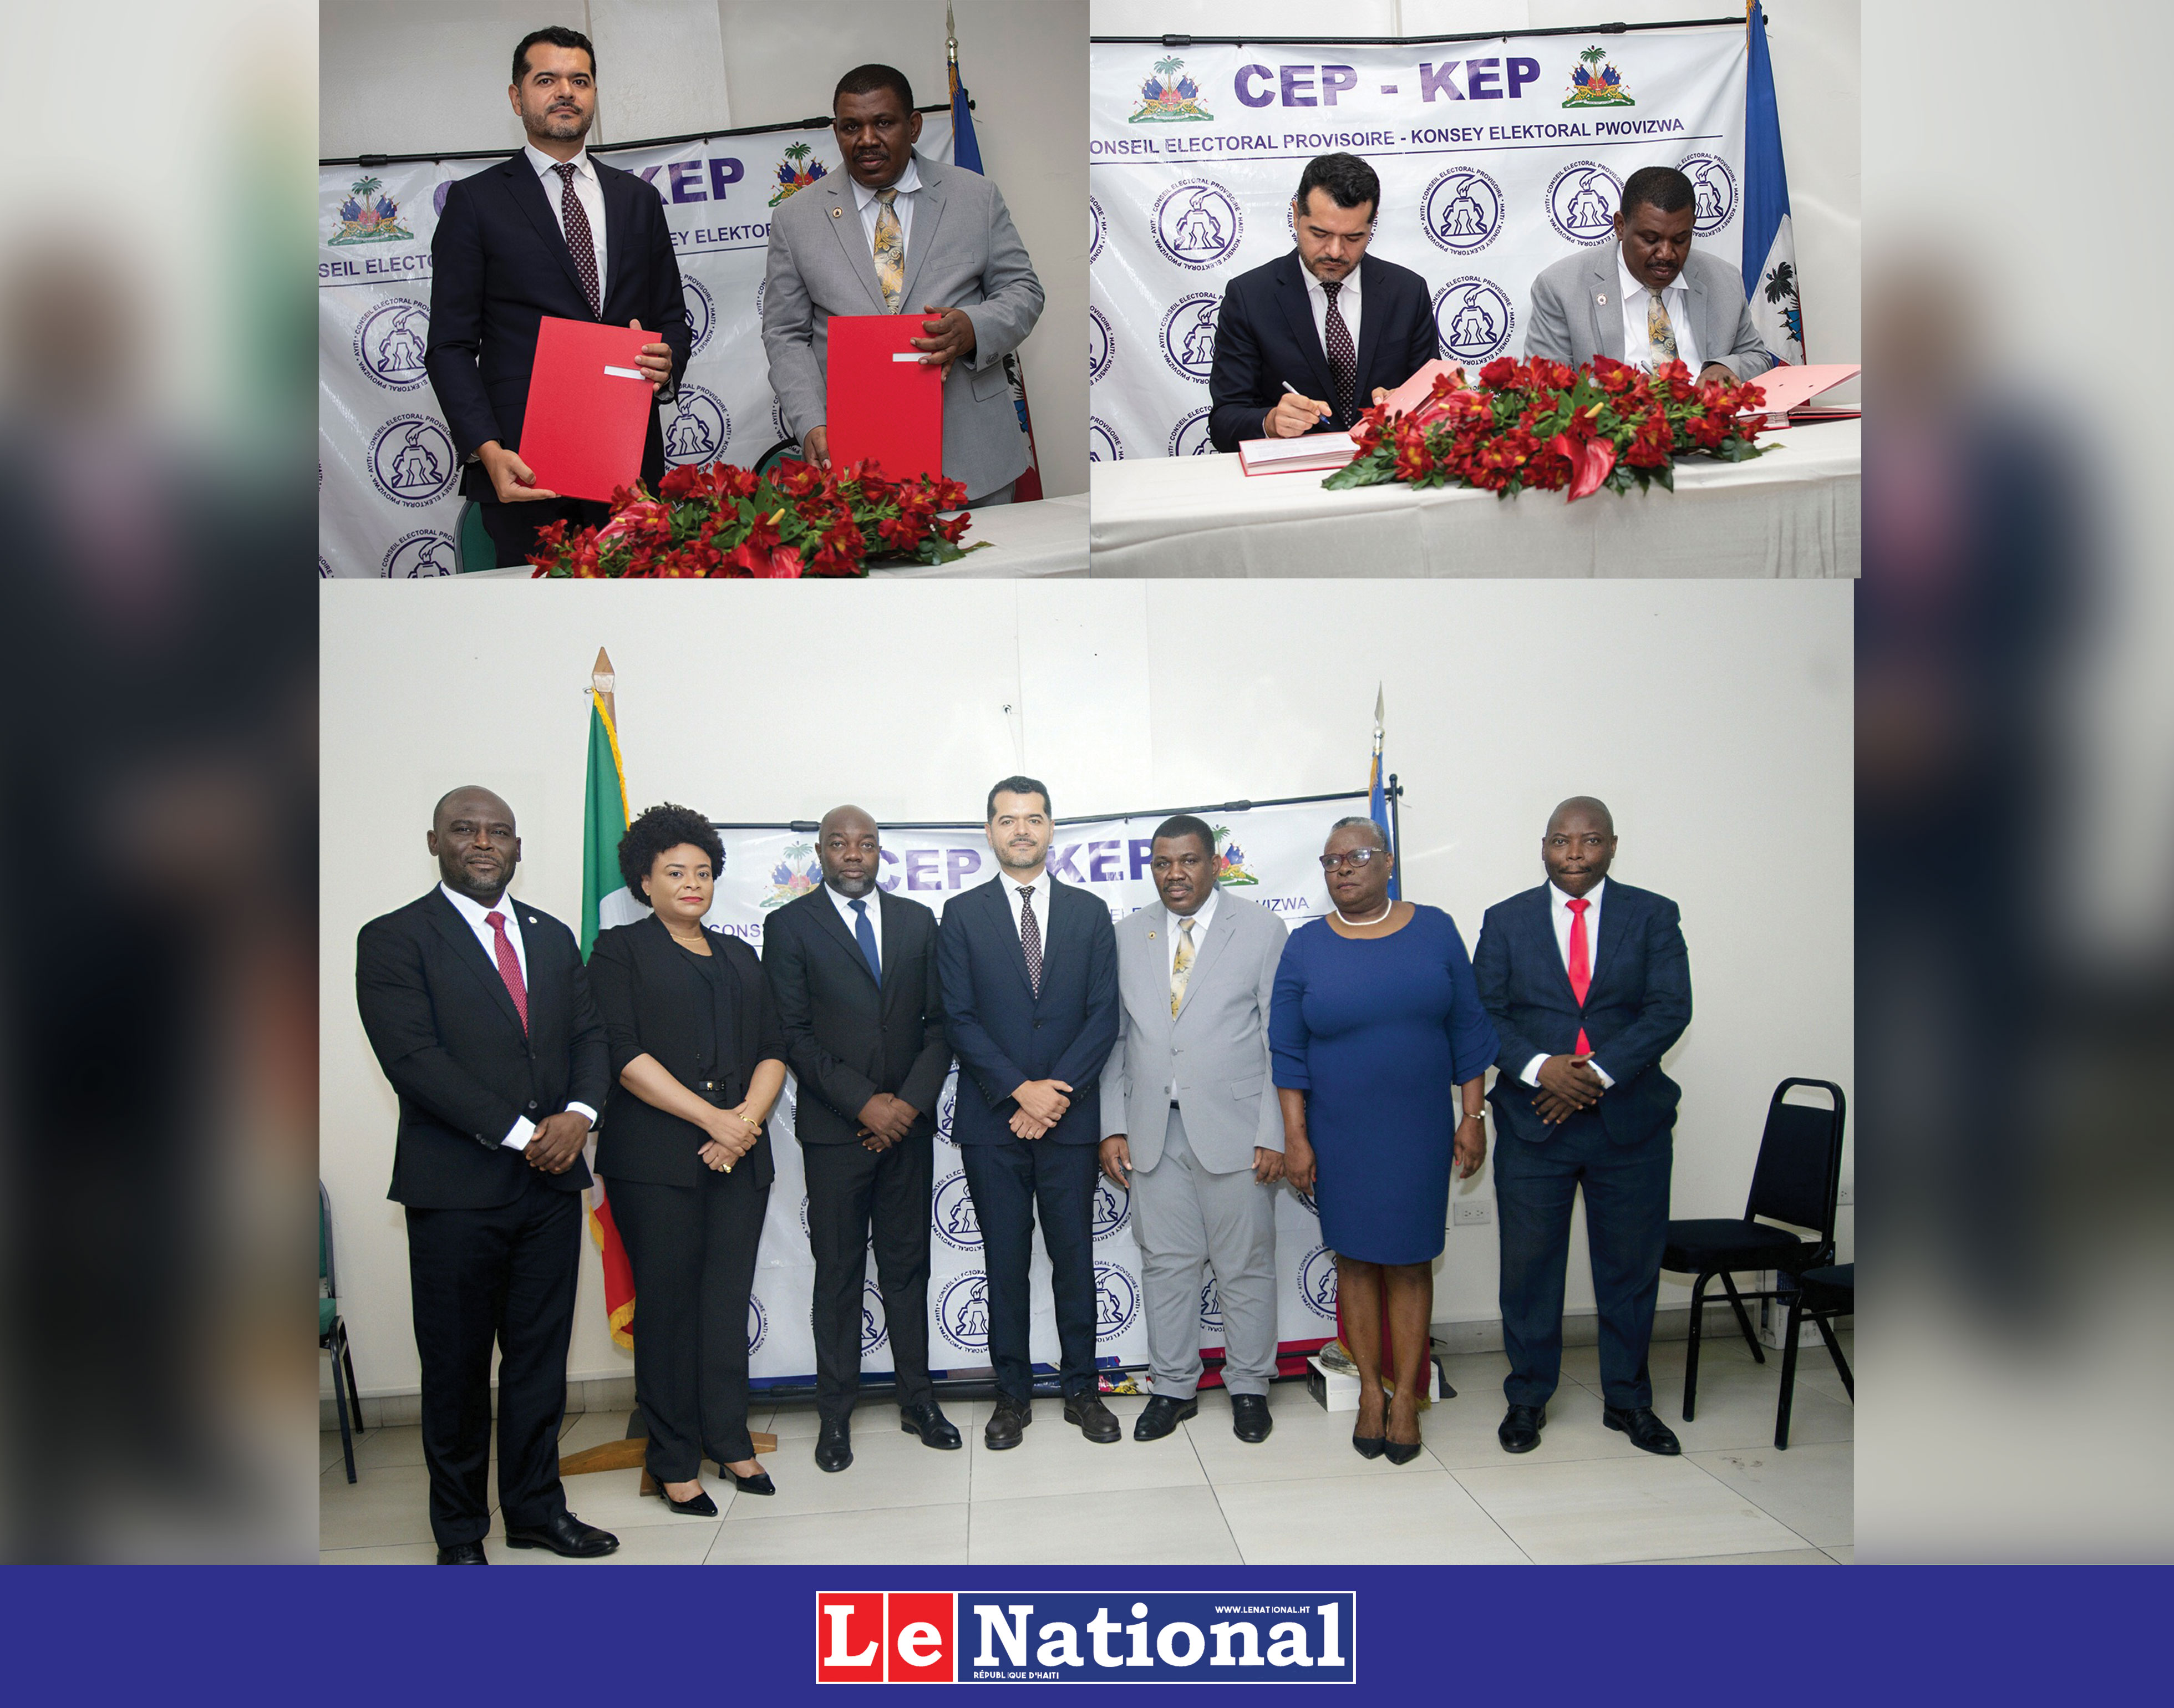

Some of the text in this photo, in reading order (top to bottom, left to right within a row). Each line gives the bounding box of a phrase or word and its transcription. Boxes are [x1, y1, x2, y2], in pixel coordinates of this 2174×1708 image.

[1234, 64, 1358, 108] CEP
[1419, 57, 1541, 103] KEP
[1090, 139, 1160, 155] ONSEIL
[1165, 134, 1278, 153] ELECTORAL
[1283, 130, 1395, 149] PROVISOIRE
[1411, 127, 1484, 144] KONSEY
[1490, 123, 1592, 140] ELEKTORAL
[1595, 118, 1685, 136] PWOVIZWA
[1563, 161, 1596, 171] ELECTORAL
[1681, 152, 1712, 163] ELECTORAL
[1713, 155, 1736, 182] PROVISOIRE
[1439, 166, 1475, 178] ELECTORAL
[1476, 169, 1502, 197] PROVISOIRE
[1546, 169, 1563, 193] CONSEIL
[1422, 175, 1440, 200] CONSEIL
[1720, 208, 1736, 228] KONSEY
[1423, 226, 1447, 252] PWOVIZWA
[1485, 225, 1502, 246] KONSEY
[1549, 218, 1574, 243] PWOVIZWA
[1576, 236, 1611, 246] ELEKTORAL
[1154, 239, 1182, 266] PWOVIZWA
[1222, 238, 1240, 261] KONSEY
[1449, 244, 1485, 255] ELEKTORAL
[319, 261, 360, 278] SEIL
[1182, 259, 1222, 270] ELEKTORAL
[684, 274, 713, 302] PROVISOIRE
[1446, 276, 1481, 288] ELECTORAL
[1482, 278, 1511, 306] PROVISOIRE
[373, 298, 412, 311] ELECTORAL
[1179, 292, 1217, 303] ELECTORAL
[355, 309, 373, 334] CONSEIL
[1090, 305, 1112, 332] OVISOIRE
[1160, 301, 1180, 327] CONSEIL
[697, 329, 713, 352] KONSEY
[1494, 333, 1512, 356] KONSEY
[358, 361, 386, 388] PWOVIZWA
[1094, 359, 1113, 383] KONSEY
[1163, 353, 1190, 380] PWOVIZWA
[388, 379, 427, 391] ELEKTORAL
[386, 413, 424, 426] ELECTORAL
[696, 385, 727, 413] PROVISOIRE
[712, 440, 730, 464] KONSEY
[1169, 416, 1188, 440] CONSEIL
[1187, 405, 1212, 418] ELECTO
[368, 424, 387, 450] CONSEIL
[372, 477, 400, 504] PWOVIZWA
[440, 473, 459, 497] KONSEY
[402, 495, 440, 507] ELEKTORAL
[382, 541, 399, 567] CONSEIL
[398, 529, 437, 543] ELECTORAL
